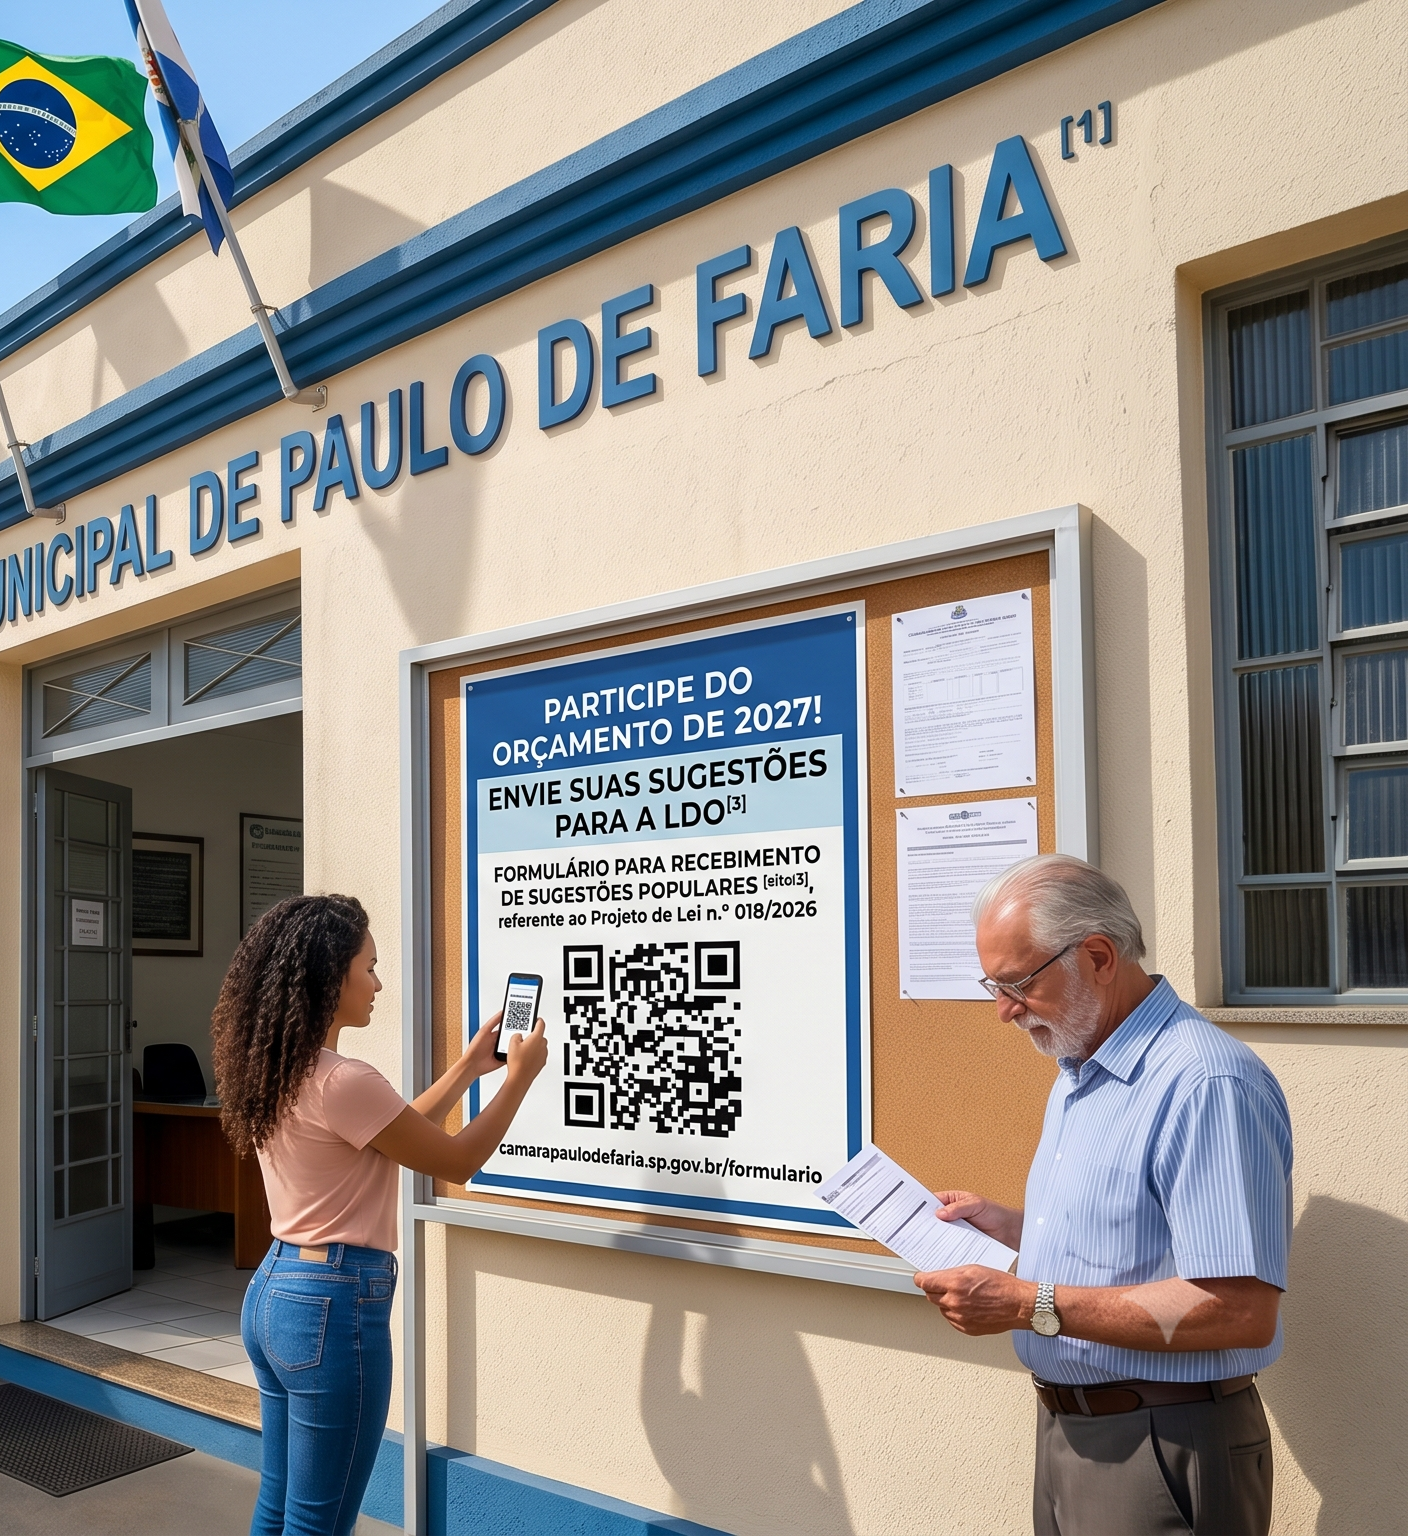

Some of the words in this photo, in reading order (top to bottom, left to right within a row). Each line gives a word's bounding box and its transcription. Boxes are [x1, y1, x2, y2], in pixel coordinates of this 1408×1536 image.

[190, 450, 260, 556] DE
[280, 353, 506, 523] PAULO
[538, 283, 656, 431] DE
[544, 676, 695, 724] PARTICIPE
[705, 666, 753, 700] DO
[492, 719, 673, 769] ORÇAMENTO
[683, 710, 725, 742] DE
[733, 694, 823, 735] 2027!
[489, 780, 562, 811] ENVIE
[569, 771, 641, 803] SUAS
[648, 746, 828, 794] SUGESTÕES
[555, 808, 629, 838] PARA
[635, 806, 657, 832] A
[494, 856, 610, 883] FORMULÁRIO
[615, 856, 667, 876] PARA
[671, 844, 821, 873] RECEBIMENTO
[501, 889, 524, 907] DE
[638, 876, 758, 900] POPULARES
[498, 912, 565, 929] referente
[568, 914, 587, 926] ao
[591, 907, 648, 928] Projeto
[651, 906, 673, 923] de
[677, 904, 701, 922] Lei
[734, 899, 818, 921] 018/2026
[499, 1142, 823, 1184] camarapaulodefaria.sp.gov.br/formulario
